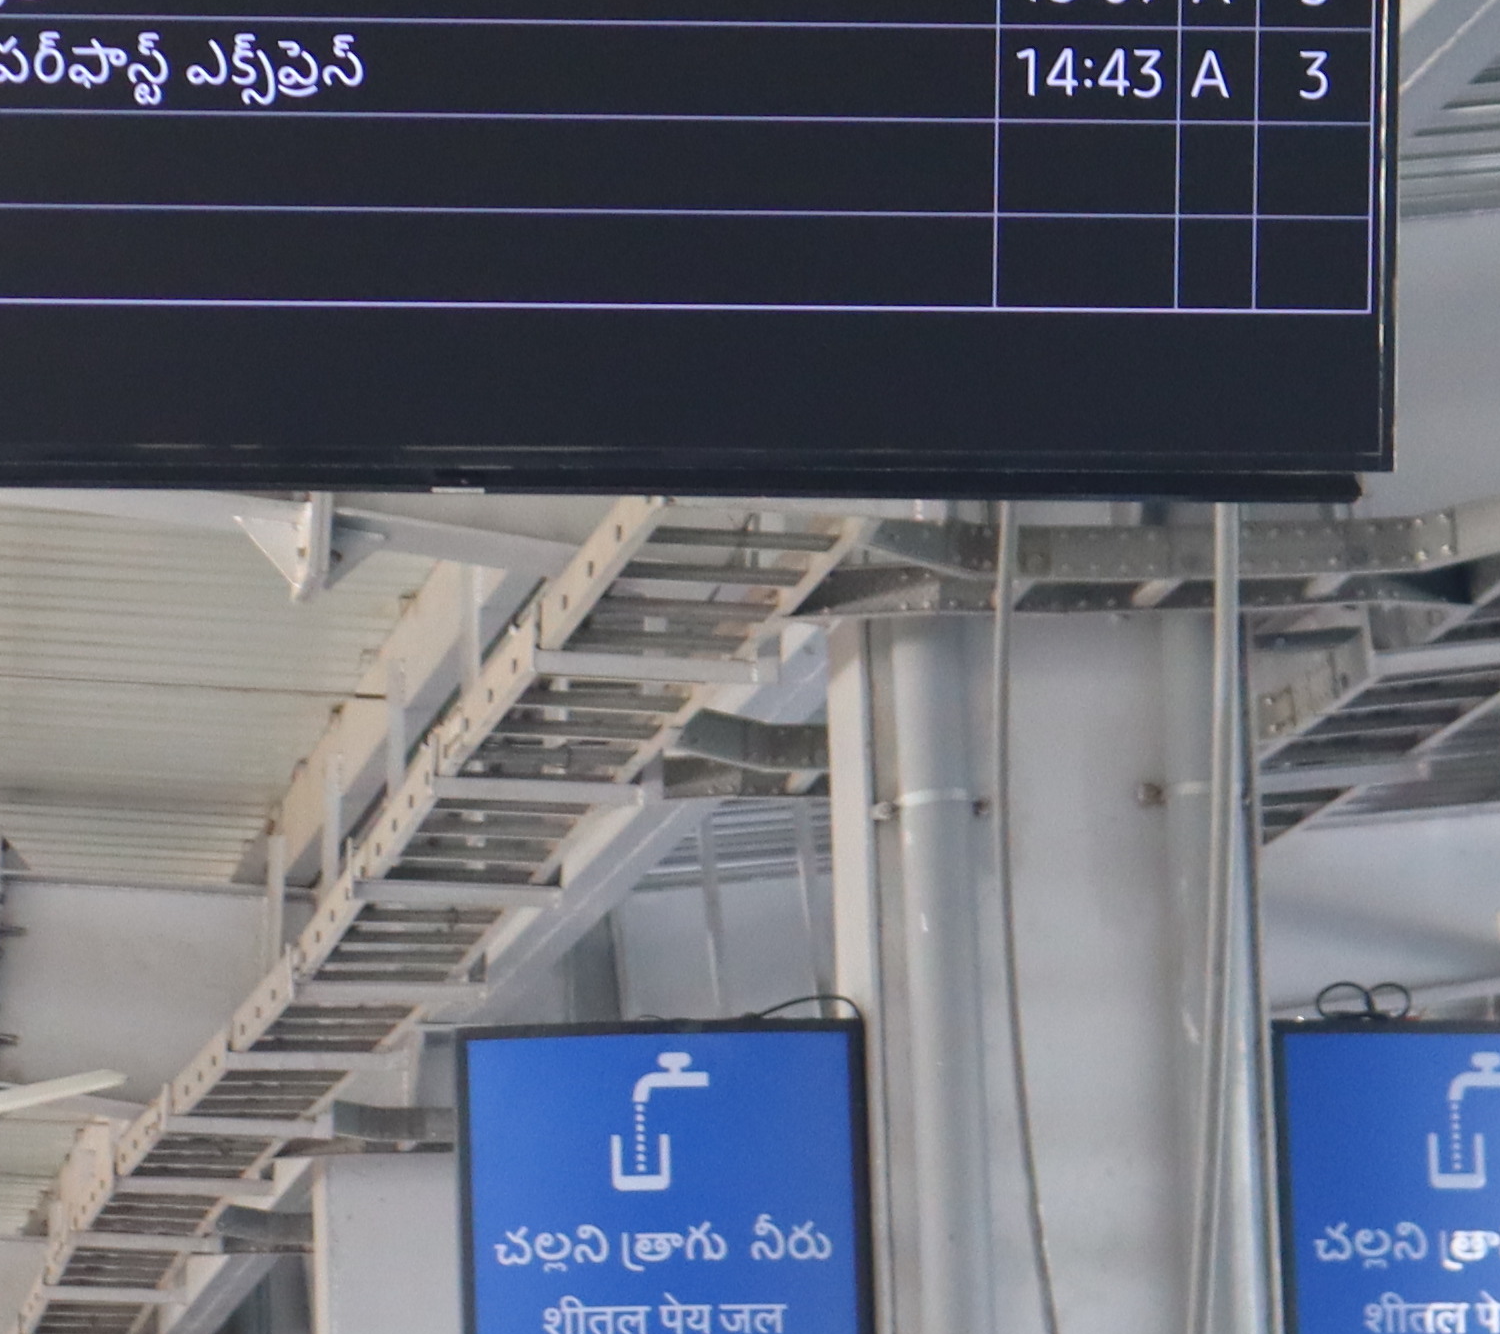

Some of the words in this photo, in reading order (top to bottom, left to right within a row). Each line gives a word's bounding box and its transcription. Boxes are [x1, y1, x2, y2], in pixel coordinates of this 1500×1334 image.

[1017, 48, 1162, 98] 14:43
[1191, 50, 1229, 98] A
[1300, 51, 1328, 99] 3
[494, 1225, 608, 1271] చల్లని
[622, 1222, 727, 1271] త్రాగు
[751, 1214, 832, 1259] నీరు
[1315, 1222, 1428, 1267] చల్లని
[659, 1293, 712, 1334] पेय
[719, 1304, 787, 1333] जल
[1367, 1294, 1469, 1334] शीतल
